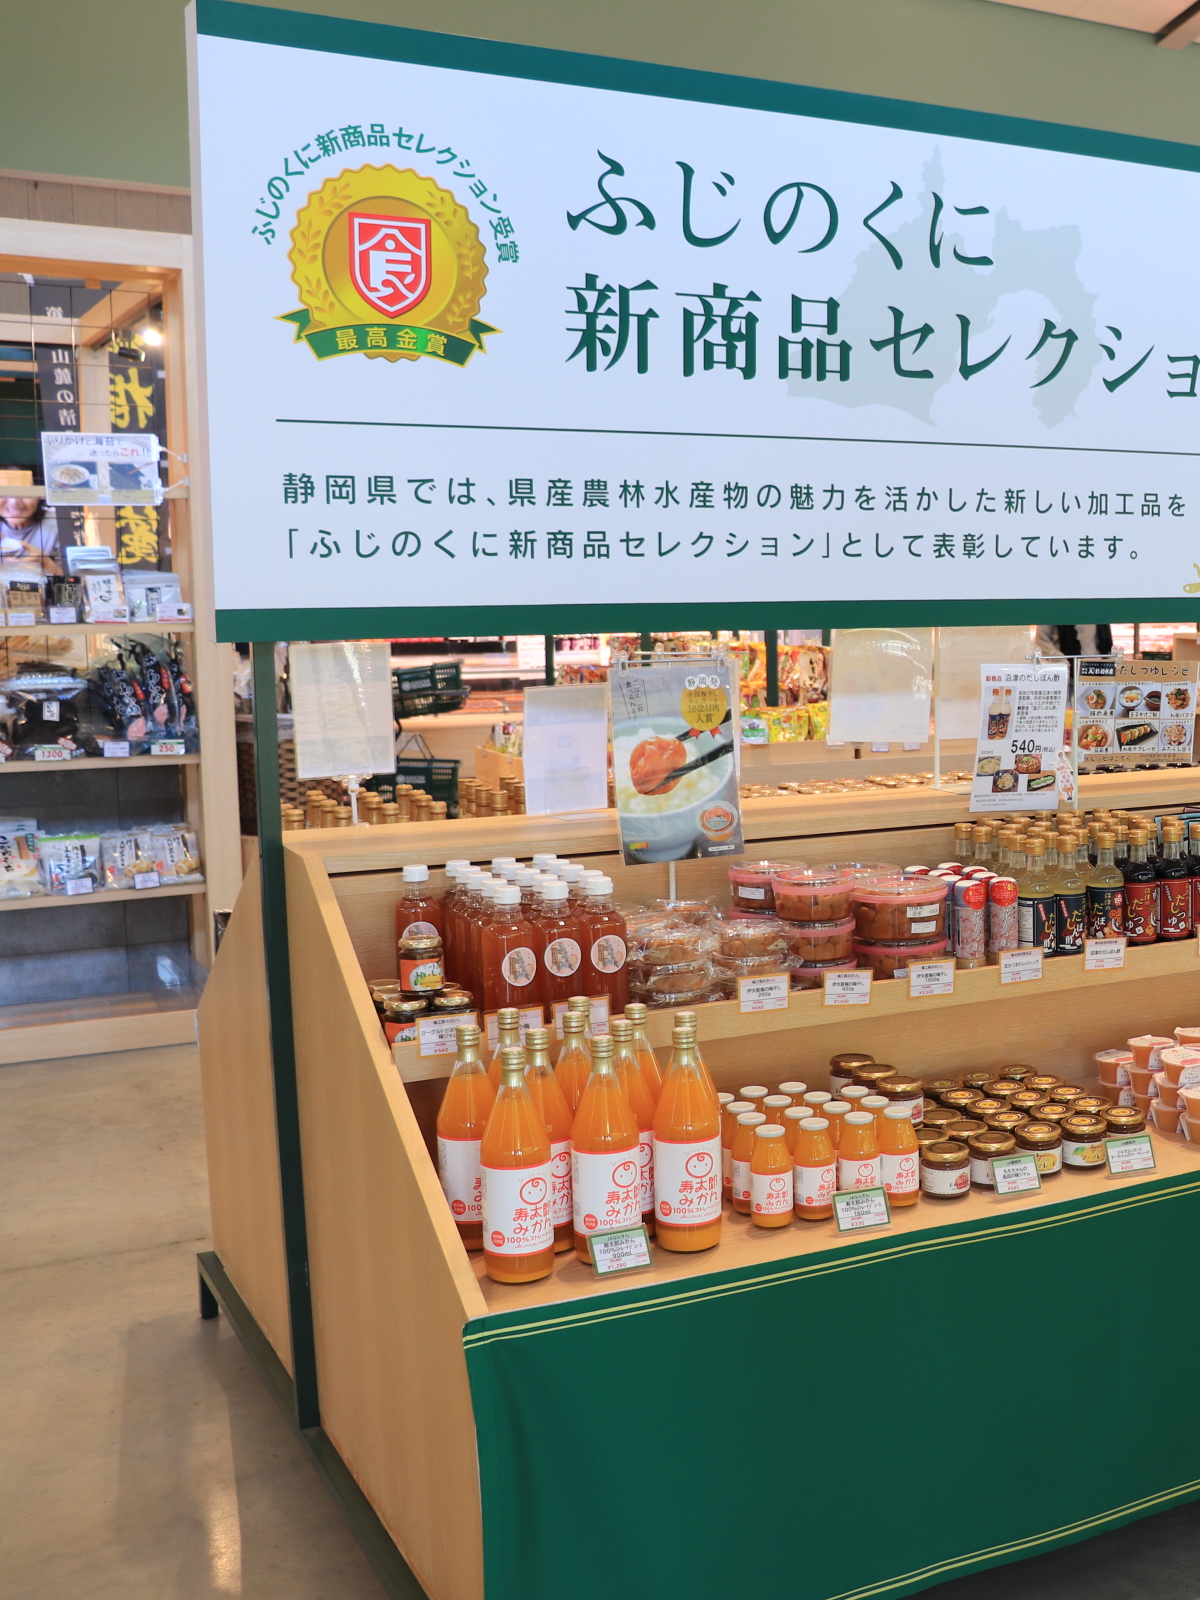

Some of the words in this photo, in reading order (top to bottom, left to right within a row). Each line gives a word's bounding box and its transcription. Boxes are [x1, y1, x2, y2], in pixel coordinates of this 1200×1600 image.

[251, 123, 520, 265] ふじのくに新商品セレクション受賞
[565, 148, 995, 271] ふじのくに
[335, 326, 449, 357] 最高金賞
[281, 472, 1187, 518] 静岡県では、県産農林水産物の魅力を活かした新しい加工品を
[287, 528, 1142, 561] 「ふじのくに新商品セレクション」として表彰しています。
[1005, 673, 1060, 682] 沼津のだしぽん酢
[1120, 665, 1190, 676] だしつゆレシピ
[696, 713, 714, 723] 入賞
[41, 750, 63, 759] 1300
[158, 744, 175, 753] 250
[679, 1174, 717, 1193] 寿太郎
[605, 1183, 640, 1205] 寿太郎
[679, 1191, 718, 1207] みかん
[512, 1200, 551, 1222] 寿太郎
[606, 1199, 641, 1219] みかん
[854, 1209, 872, 1217] 180ml
[513, 1217, 552, 1236] みかん
[612, 1250, 632, 1259] 900ml
[607, 1262, 628, 1270] ¥1,280
